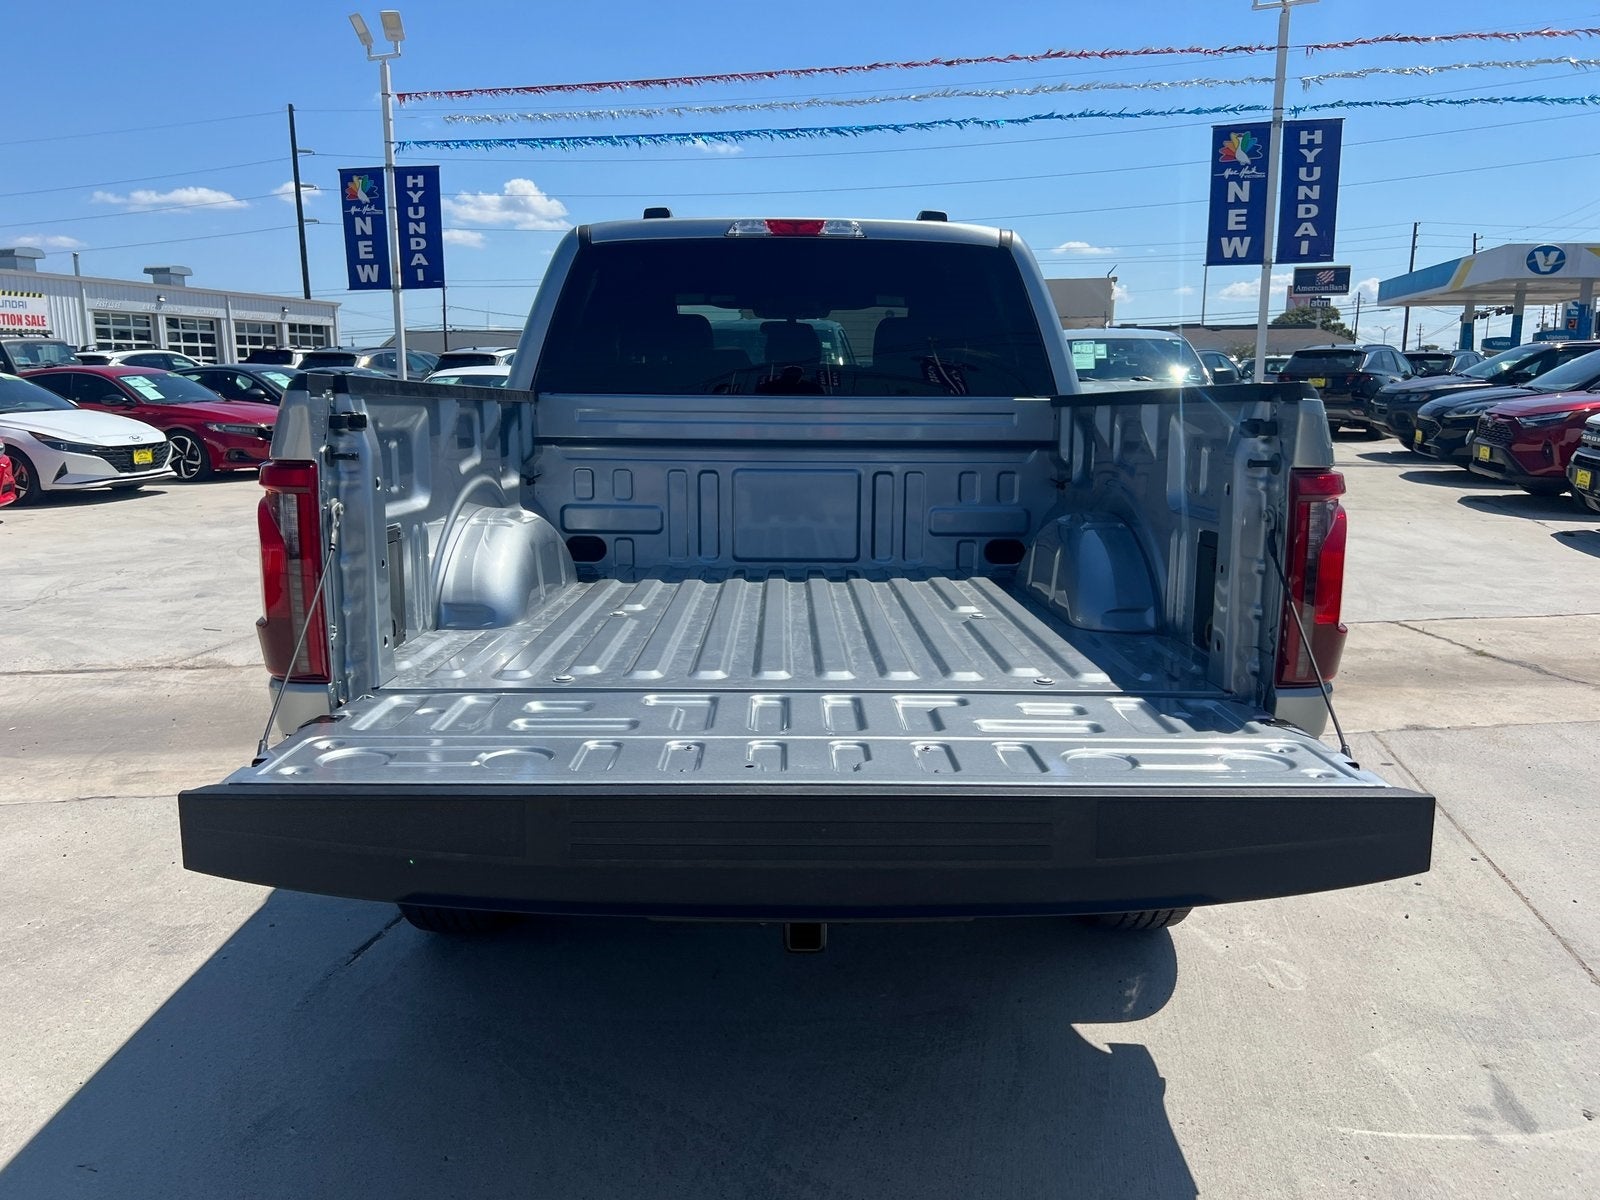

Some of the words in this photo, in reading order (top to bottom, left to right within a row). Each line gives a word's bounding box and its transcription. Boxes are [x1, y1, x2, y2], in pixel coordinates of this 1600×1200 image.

[406, 175, 429, 281] HYUNDAI
[1220, 181, 1252, 259] NEW
[1294, 130, 1323, 256] HYUNDAI
[354, 216, 379, 283] NEW
[0, 313, 23, 326] TION
[25, 315, 47, 326] SALE
[1310, 298, 1330, 307] atm
